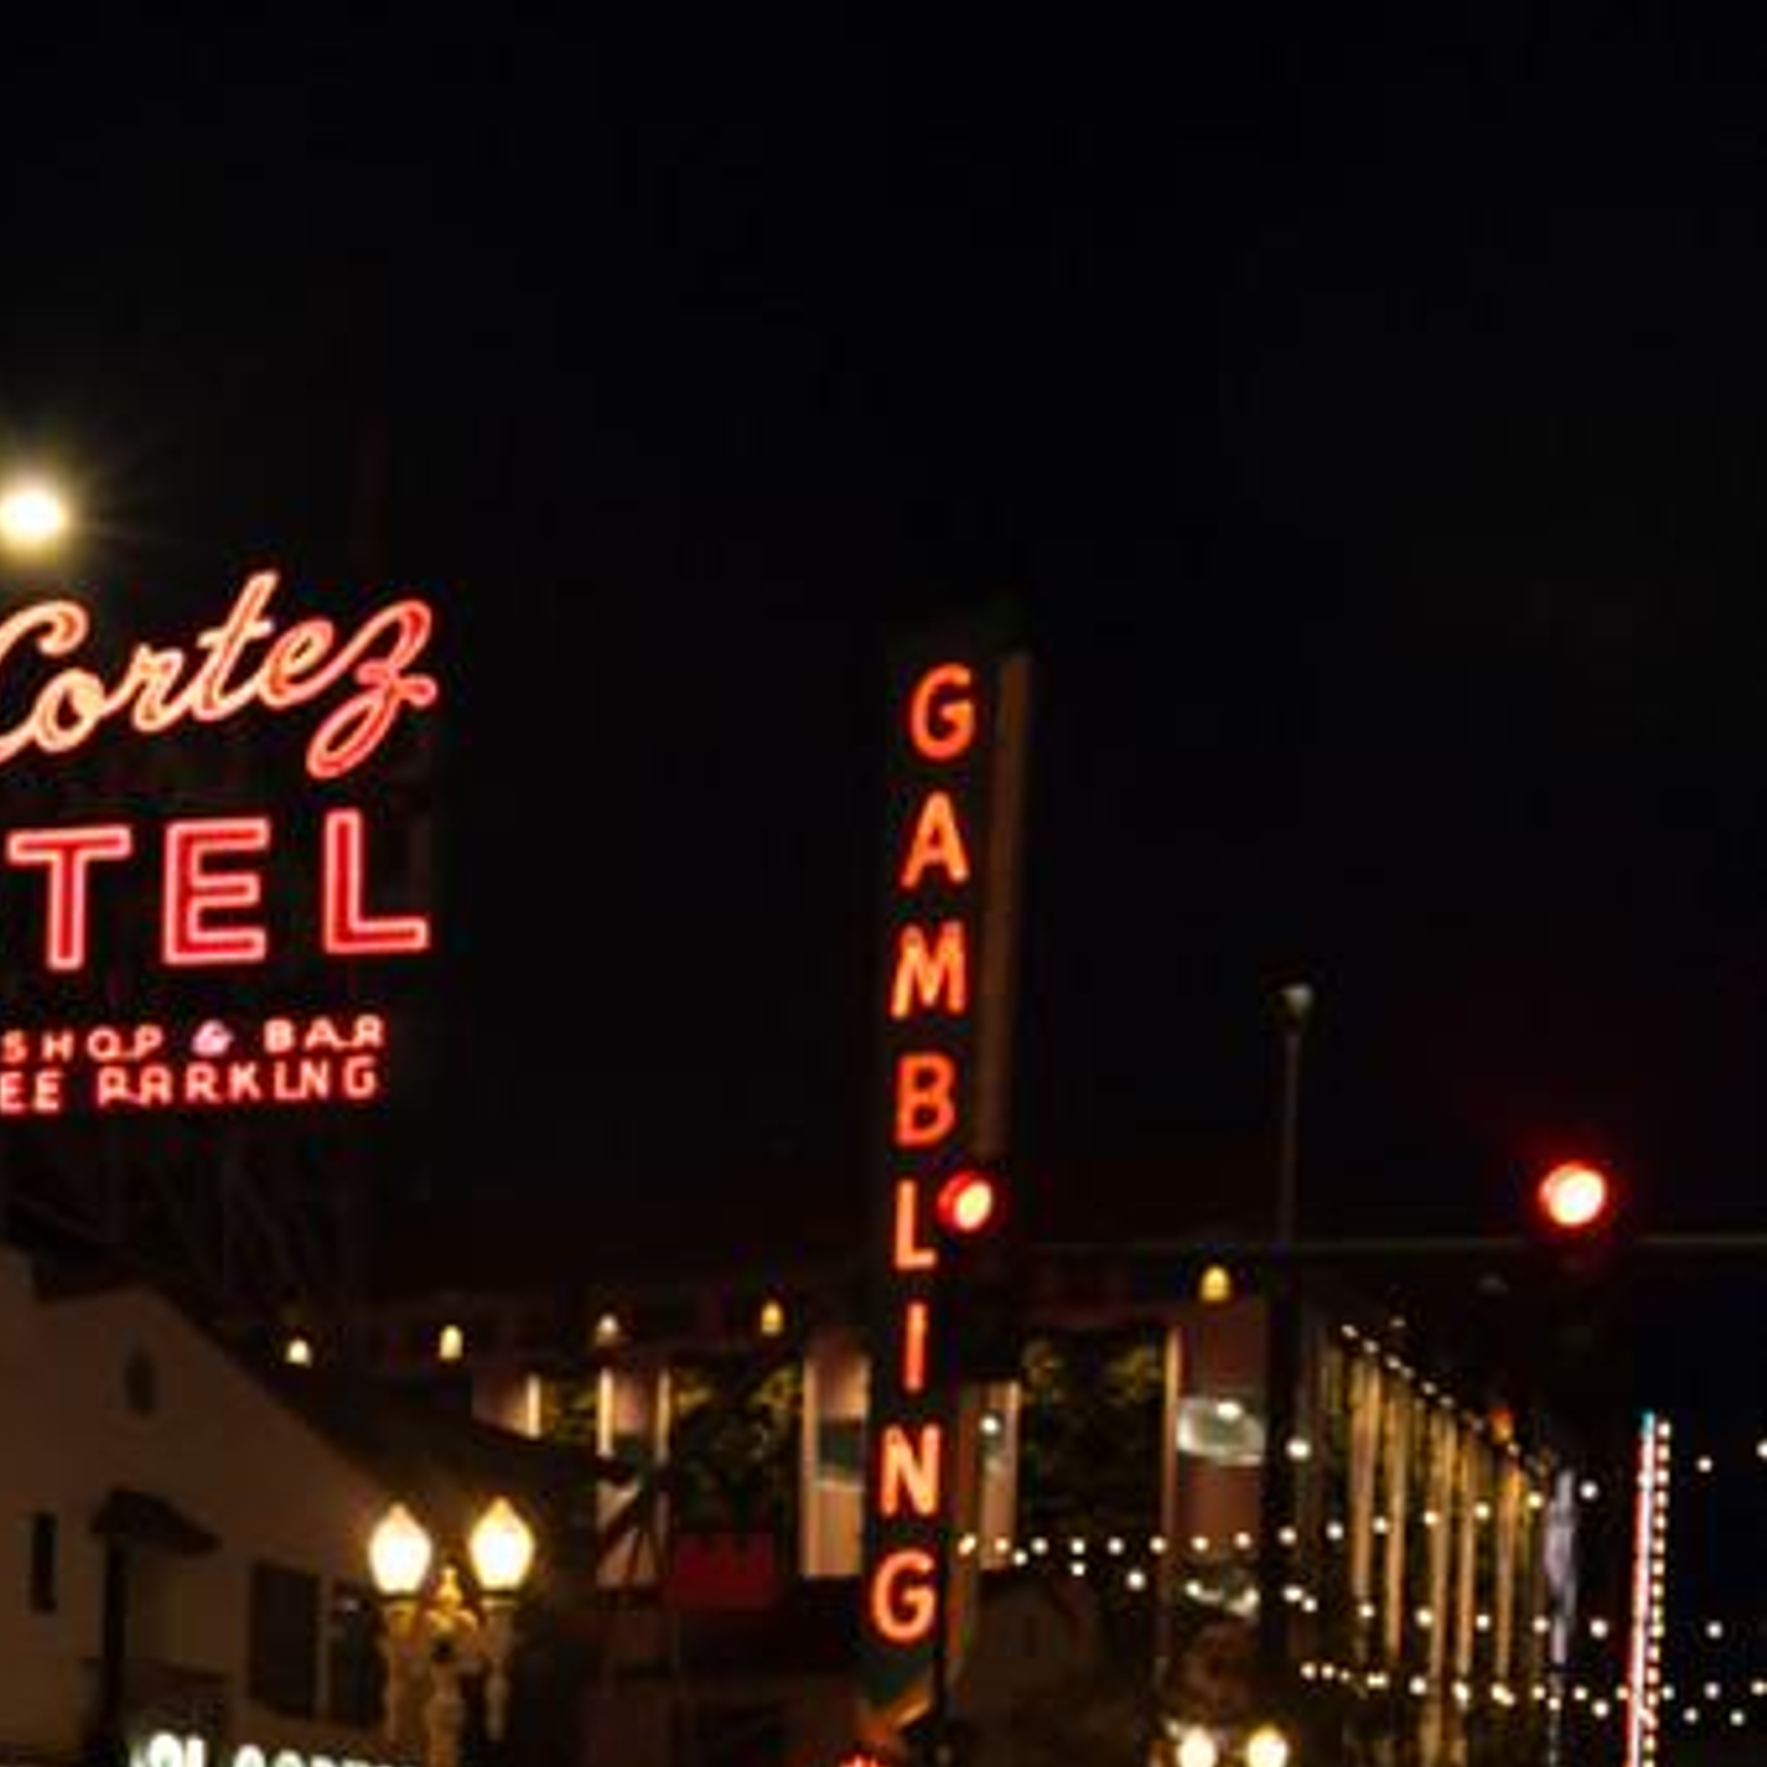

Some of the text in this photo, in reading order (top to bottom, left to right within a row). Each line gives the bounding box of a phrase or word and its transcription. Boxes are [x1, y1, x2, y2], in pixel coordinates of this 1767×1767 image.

[0, 1024, 166, 1065] SHOP
[192, 1019, 233, 1058] &
[263, 1014, 385, 1054] BAR
[97, 1054, 378, 1106] PARKING
[869, 664, 975, 1642] GAMBLING
